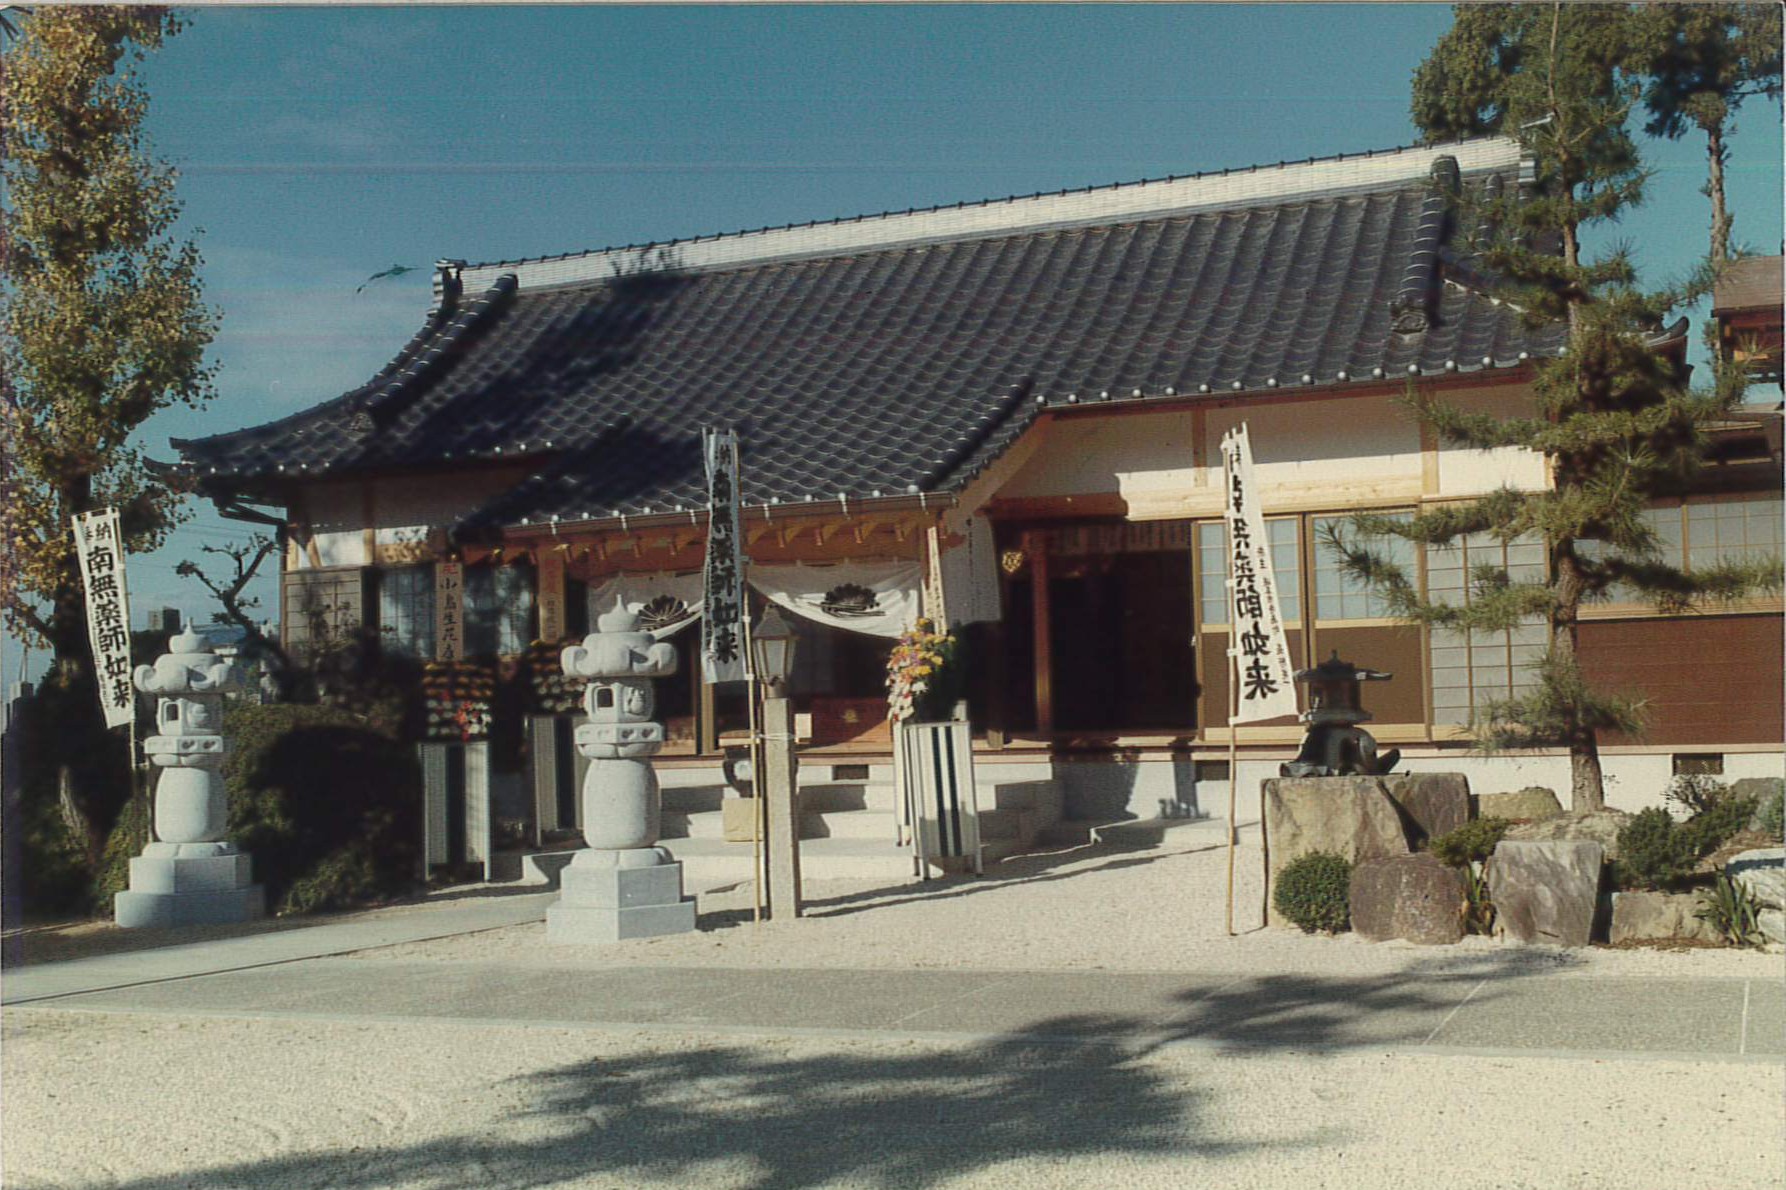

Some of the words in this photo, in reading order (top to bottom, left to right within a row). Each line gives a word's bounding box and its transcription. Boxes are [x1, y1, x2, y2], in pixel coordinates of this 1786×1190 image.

[86, 545, 131, 708] 南無薬師如来
